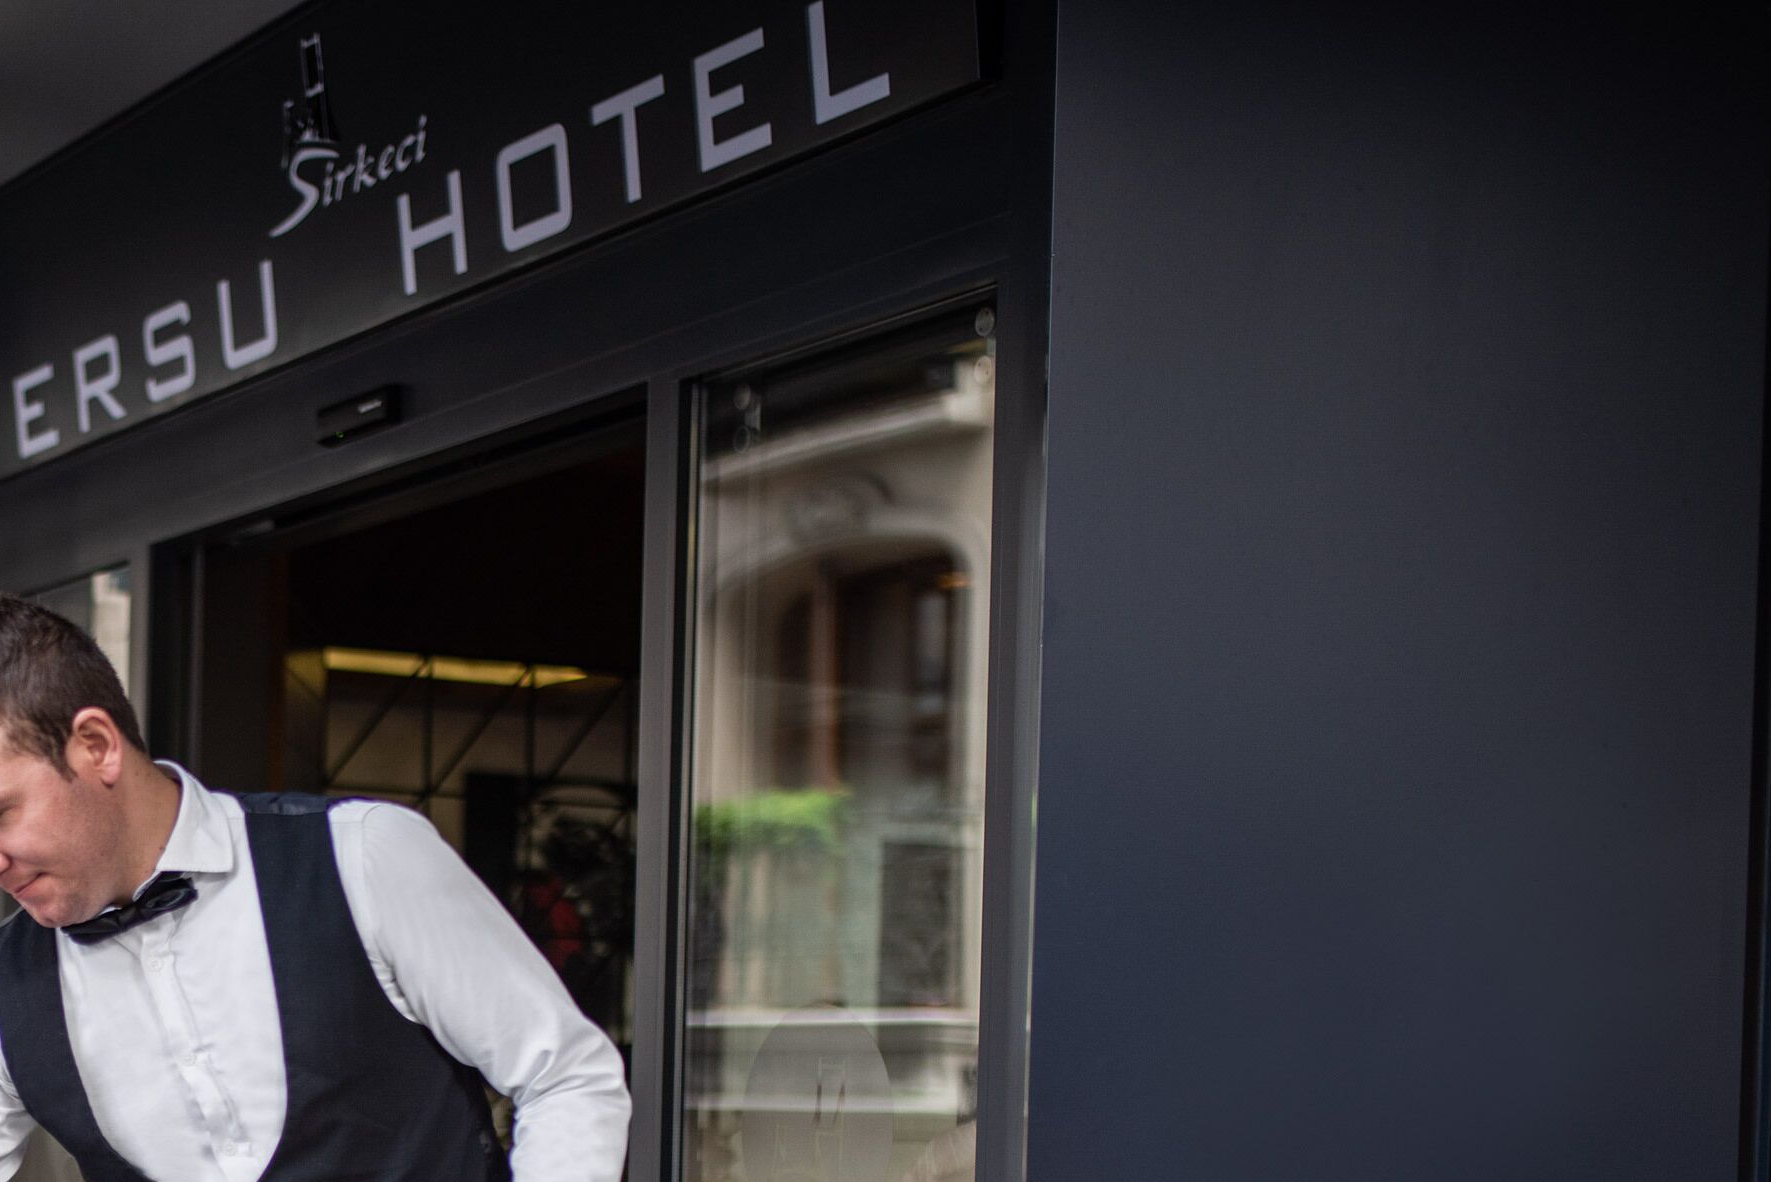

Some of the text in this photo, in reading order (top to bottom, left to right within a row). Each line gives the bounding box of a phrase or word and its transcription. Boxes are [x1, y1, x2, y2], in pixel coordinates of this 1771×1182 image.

[12, 0, 892, 458] ERSU HOTEL
[268, 114, 428, 239] Sirkeci
